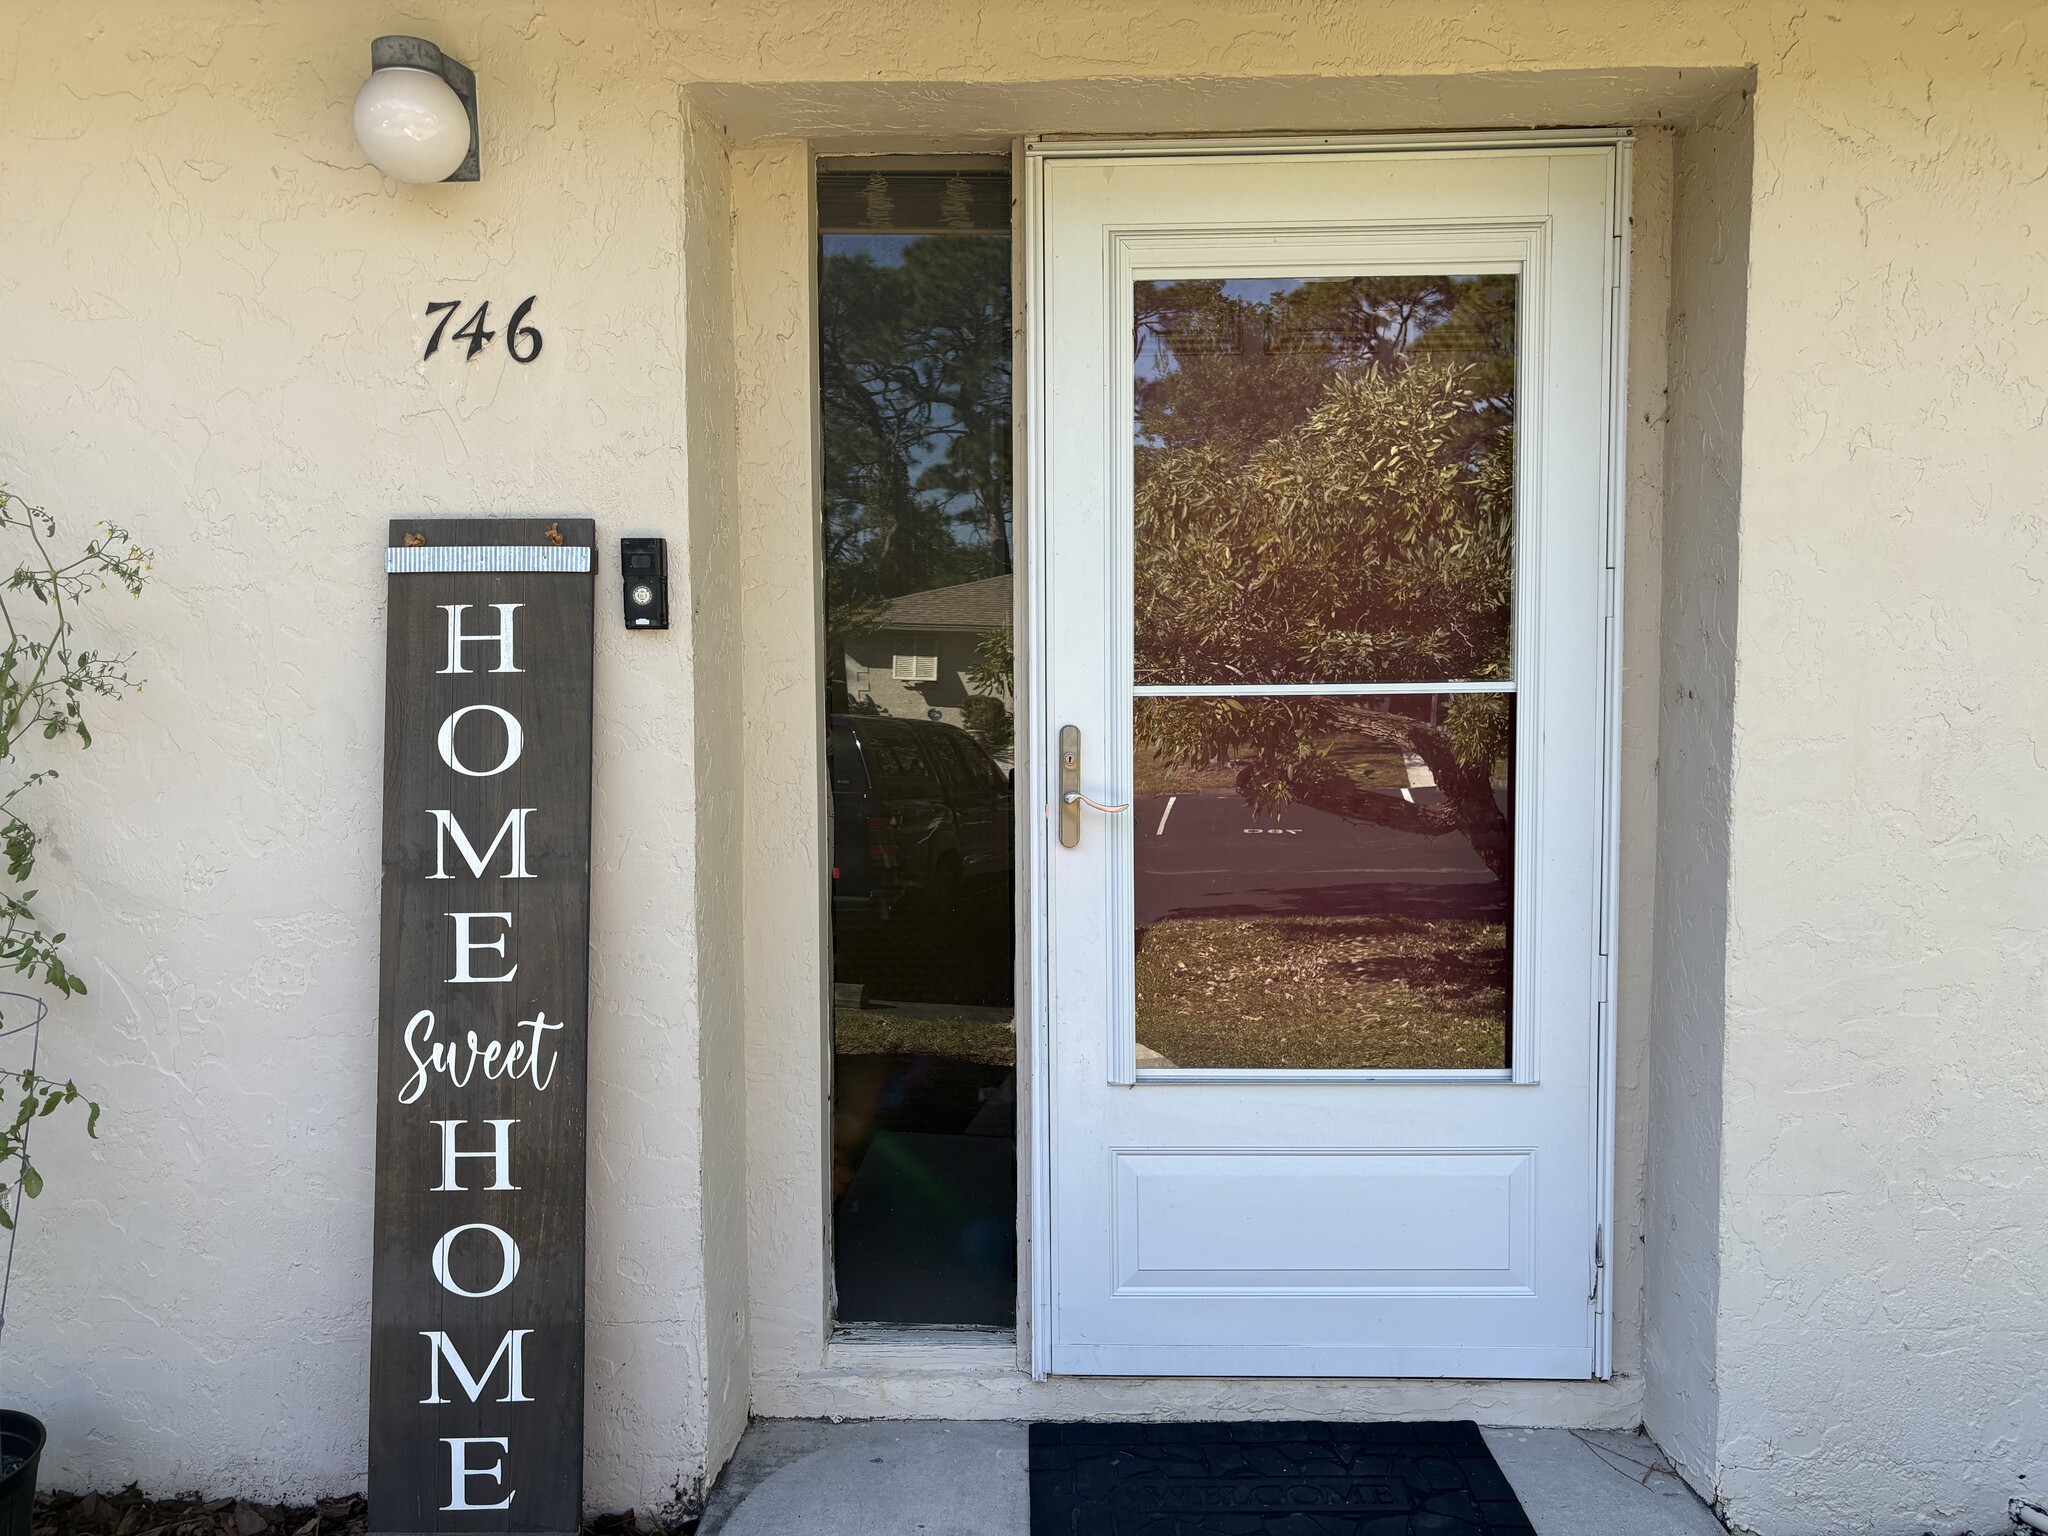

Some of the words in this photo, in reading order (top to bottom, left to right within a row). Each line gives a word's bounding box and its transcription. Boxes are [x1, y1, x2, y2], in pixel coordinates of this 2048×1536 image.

[423, 295, 543, 364] 746
[424, 603, 538, 983] HOME
[398, 1009, 565, 1105] Sweet
[418, 1119, 535, 1511] HOME
[1146, 1483, 1398, 1507] WELCOME
